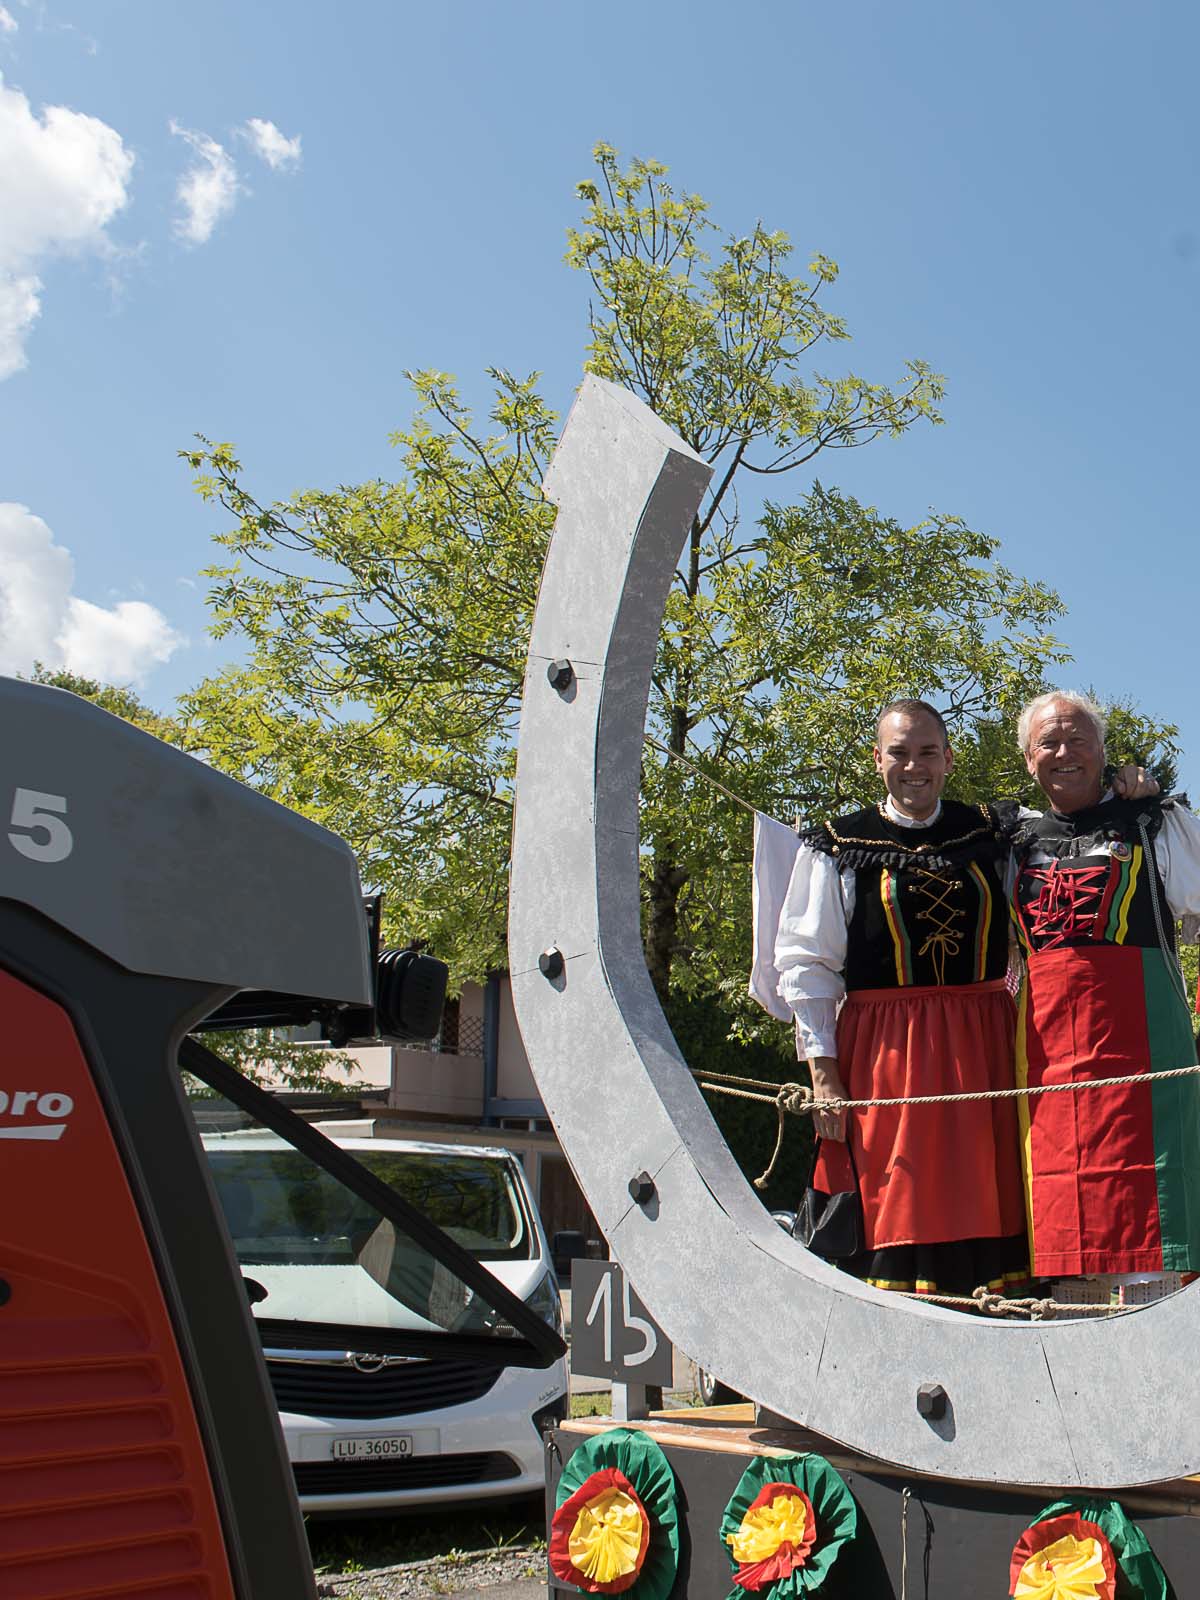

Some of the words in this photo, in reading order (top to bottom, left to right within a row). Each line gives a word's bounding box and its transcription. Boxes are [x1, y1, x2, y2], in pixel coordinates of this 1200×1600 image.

[8, 787, 73, 863] 5
[0, 1090, 74, 1118] ro
[586, 1271, 657, 1367] 15
